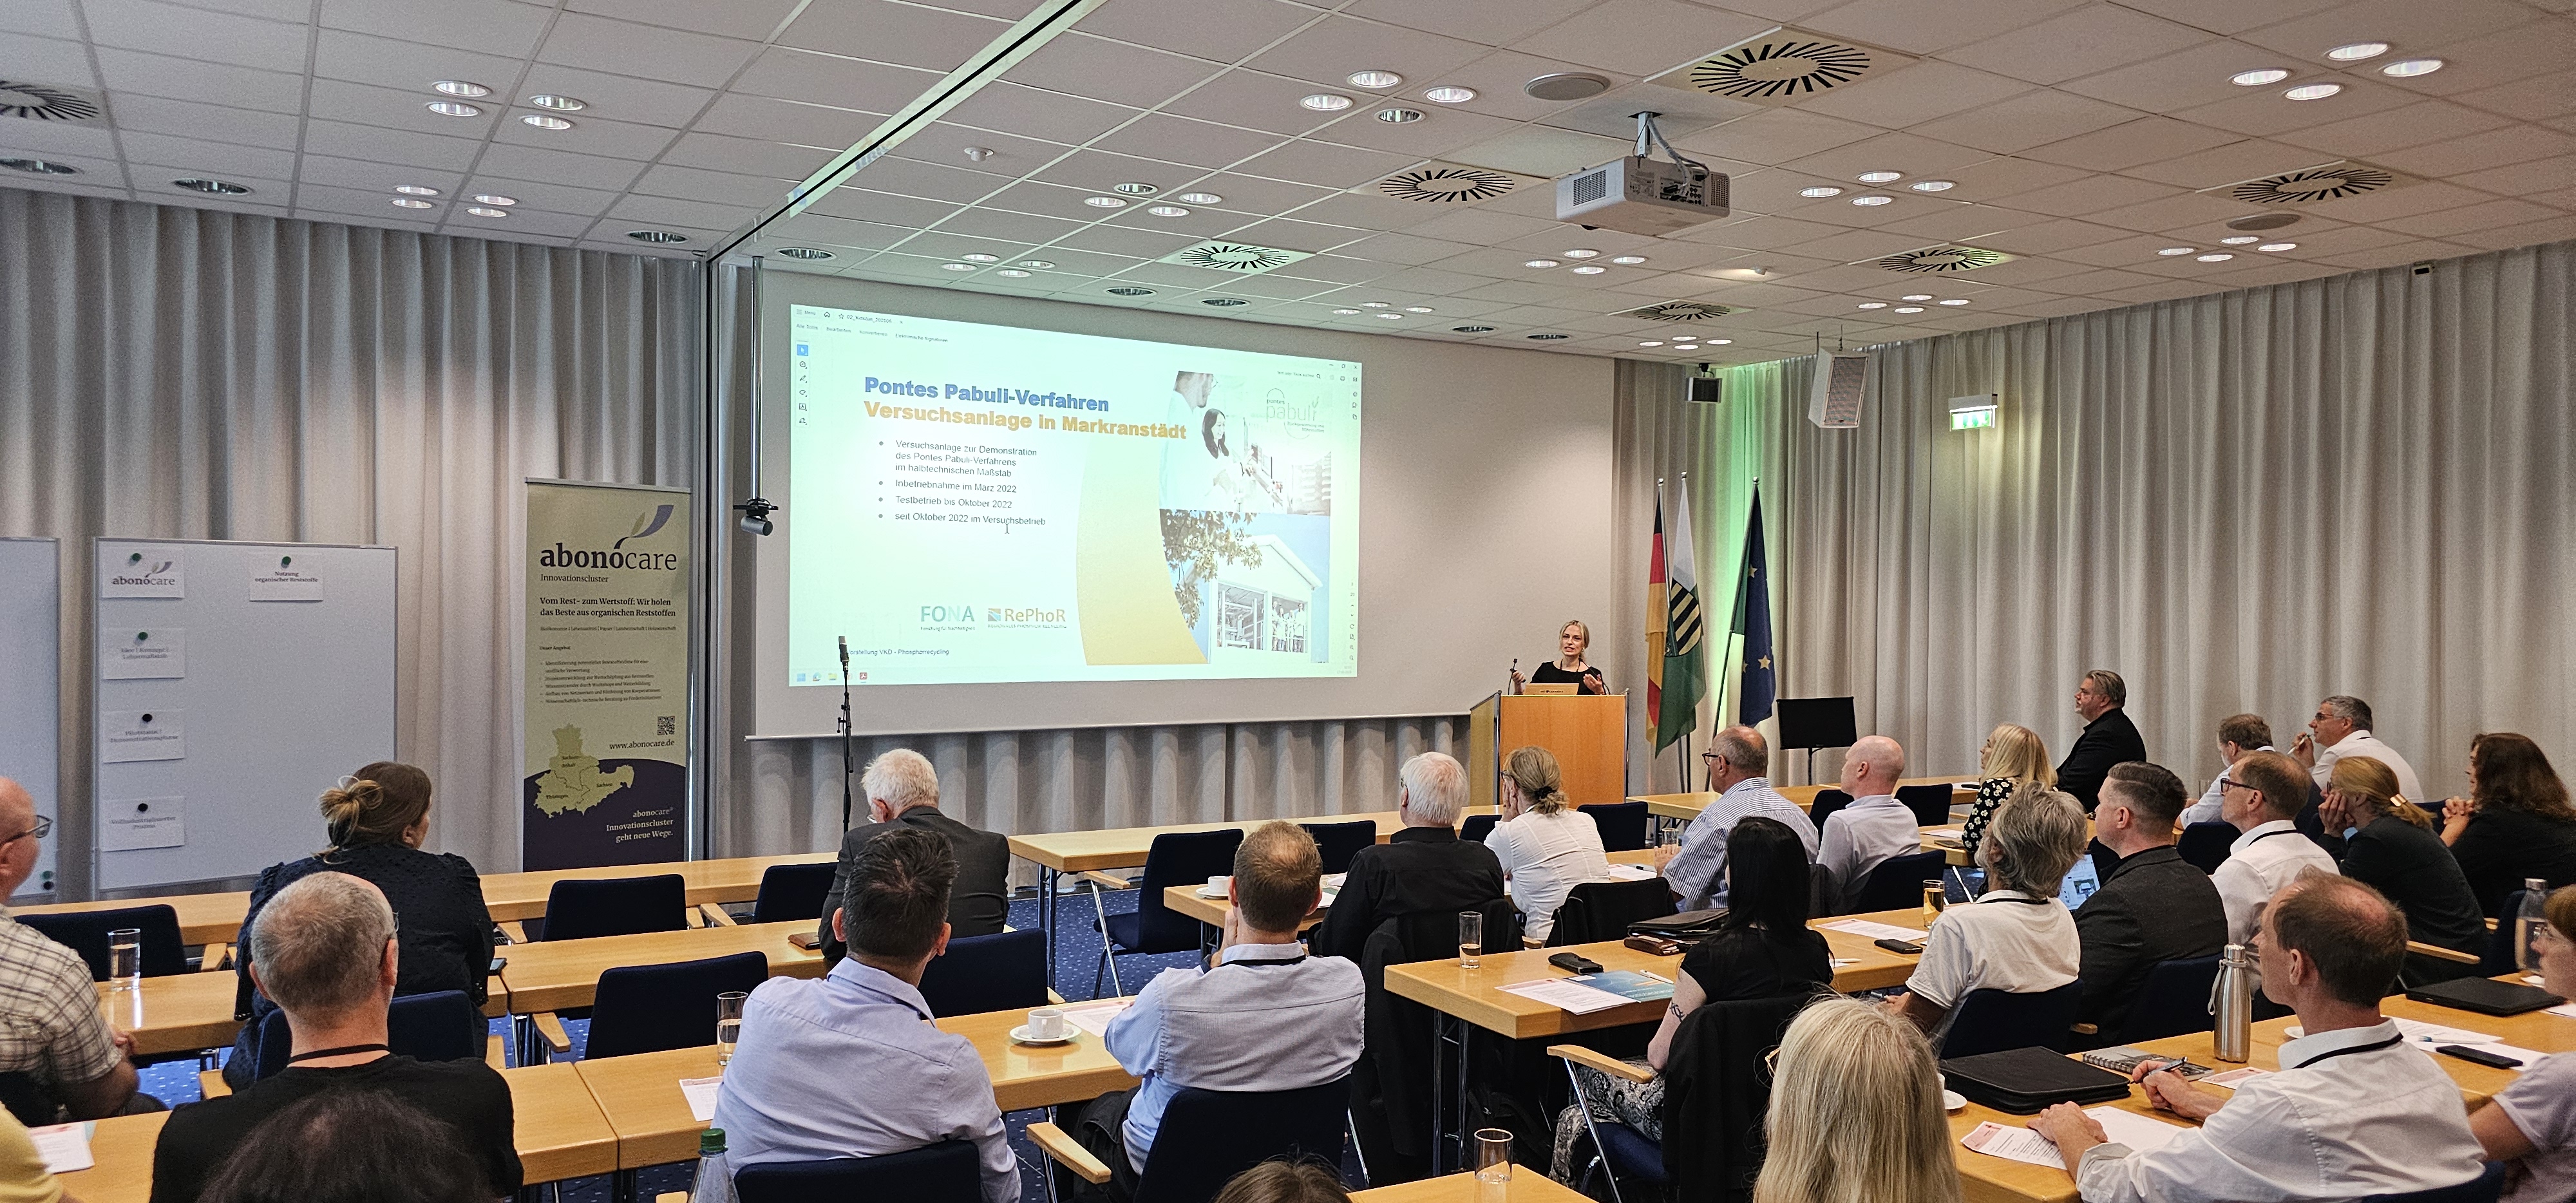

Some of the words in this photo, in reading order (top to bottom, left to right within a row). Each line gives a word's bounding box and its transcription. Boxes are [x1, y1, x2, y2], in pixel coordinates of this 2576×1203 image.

[865, 376, 939, 398] Pontes
[945, 383, 1109, 412] Pabuli-Verfahren
[864, 401, 1032, 431] Versuchsanlage
[1039, 414, 1056, 430] in
[1063, 416, 1187, 439] Markranstädt
[896, 439, 961, 453] Versuchsanlage
[979, 445, 1037, 456] Demonstration
[895, 451, 911, 460] des
[914, 452, 943, 462] Pontes
[945, 454, 1016, 466] Pabuli-Verfahrens
[908, 464, 974, 475] halbtechnischen
[977, 468, 1012, 477] Maßstab
[896, 479, 960, 490] Inbetriebnahme
[962, 482, 972, 491] im
[996, 484, 1017, 493] 2022
[895, 495, 942, 506] Testbetrieb
[958, 498, 990, 507] Oktober
[992, 500, 1012, 509] 2022
[913, 513, 946, 521] Oktober
[949, 514, 969, 522] 2022
[983, 515, 1046, 526] Versuchsbetrieb
[540, 542, 677, 570] abonocare
[112, 575, 175, 585] abonocare
[540, 574, 609, 583] Innovationscluster
[599, 597, 636, 605] Wertstoff:
[591, 609, 635, 618] organischen
[636, 609, 676, 617] Reststoffen
[921, 605, 975, 623] FONA
[1005, 608, 1066, 623] RePhoR
[609, 739, 675, 750] www.abonocare.de
[606, 819, 674, 831] Innovationscluster
[616, 833, 632, 843] geht
[651, 829, 674, 838] Wege.
